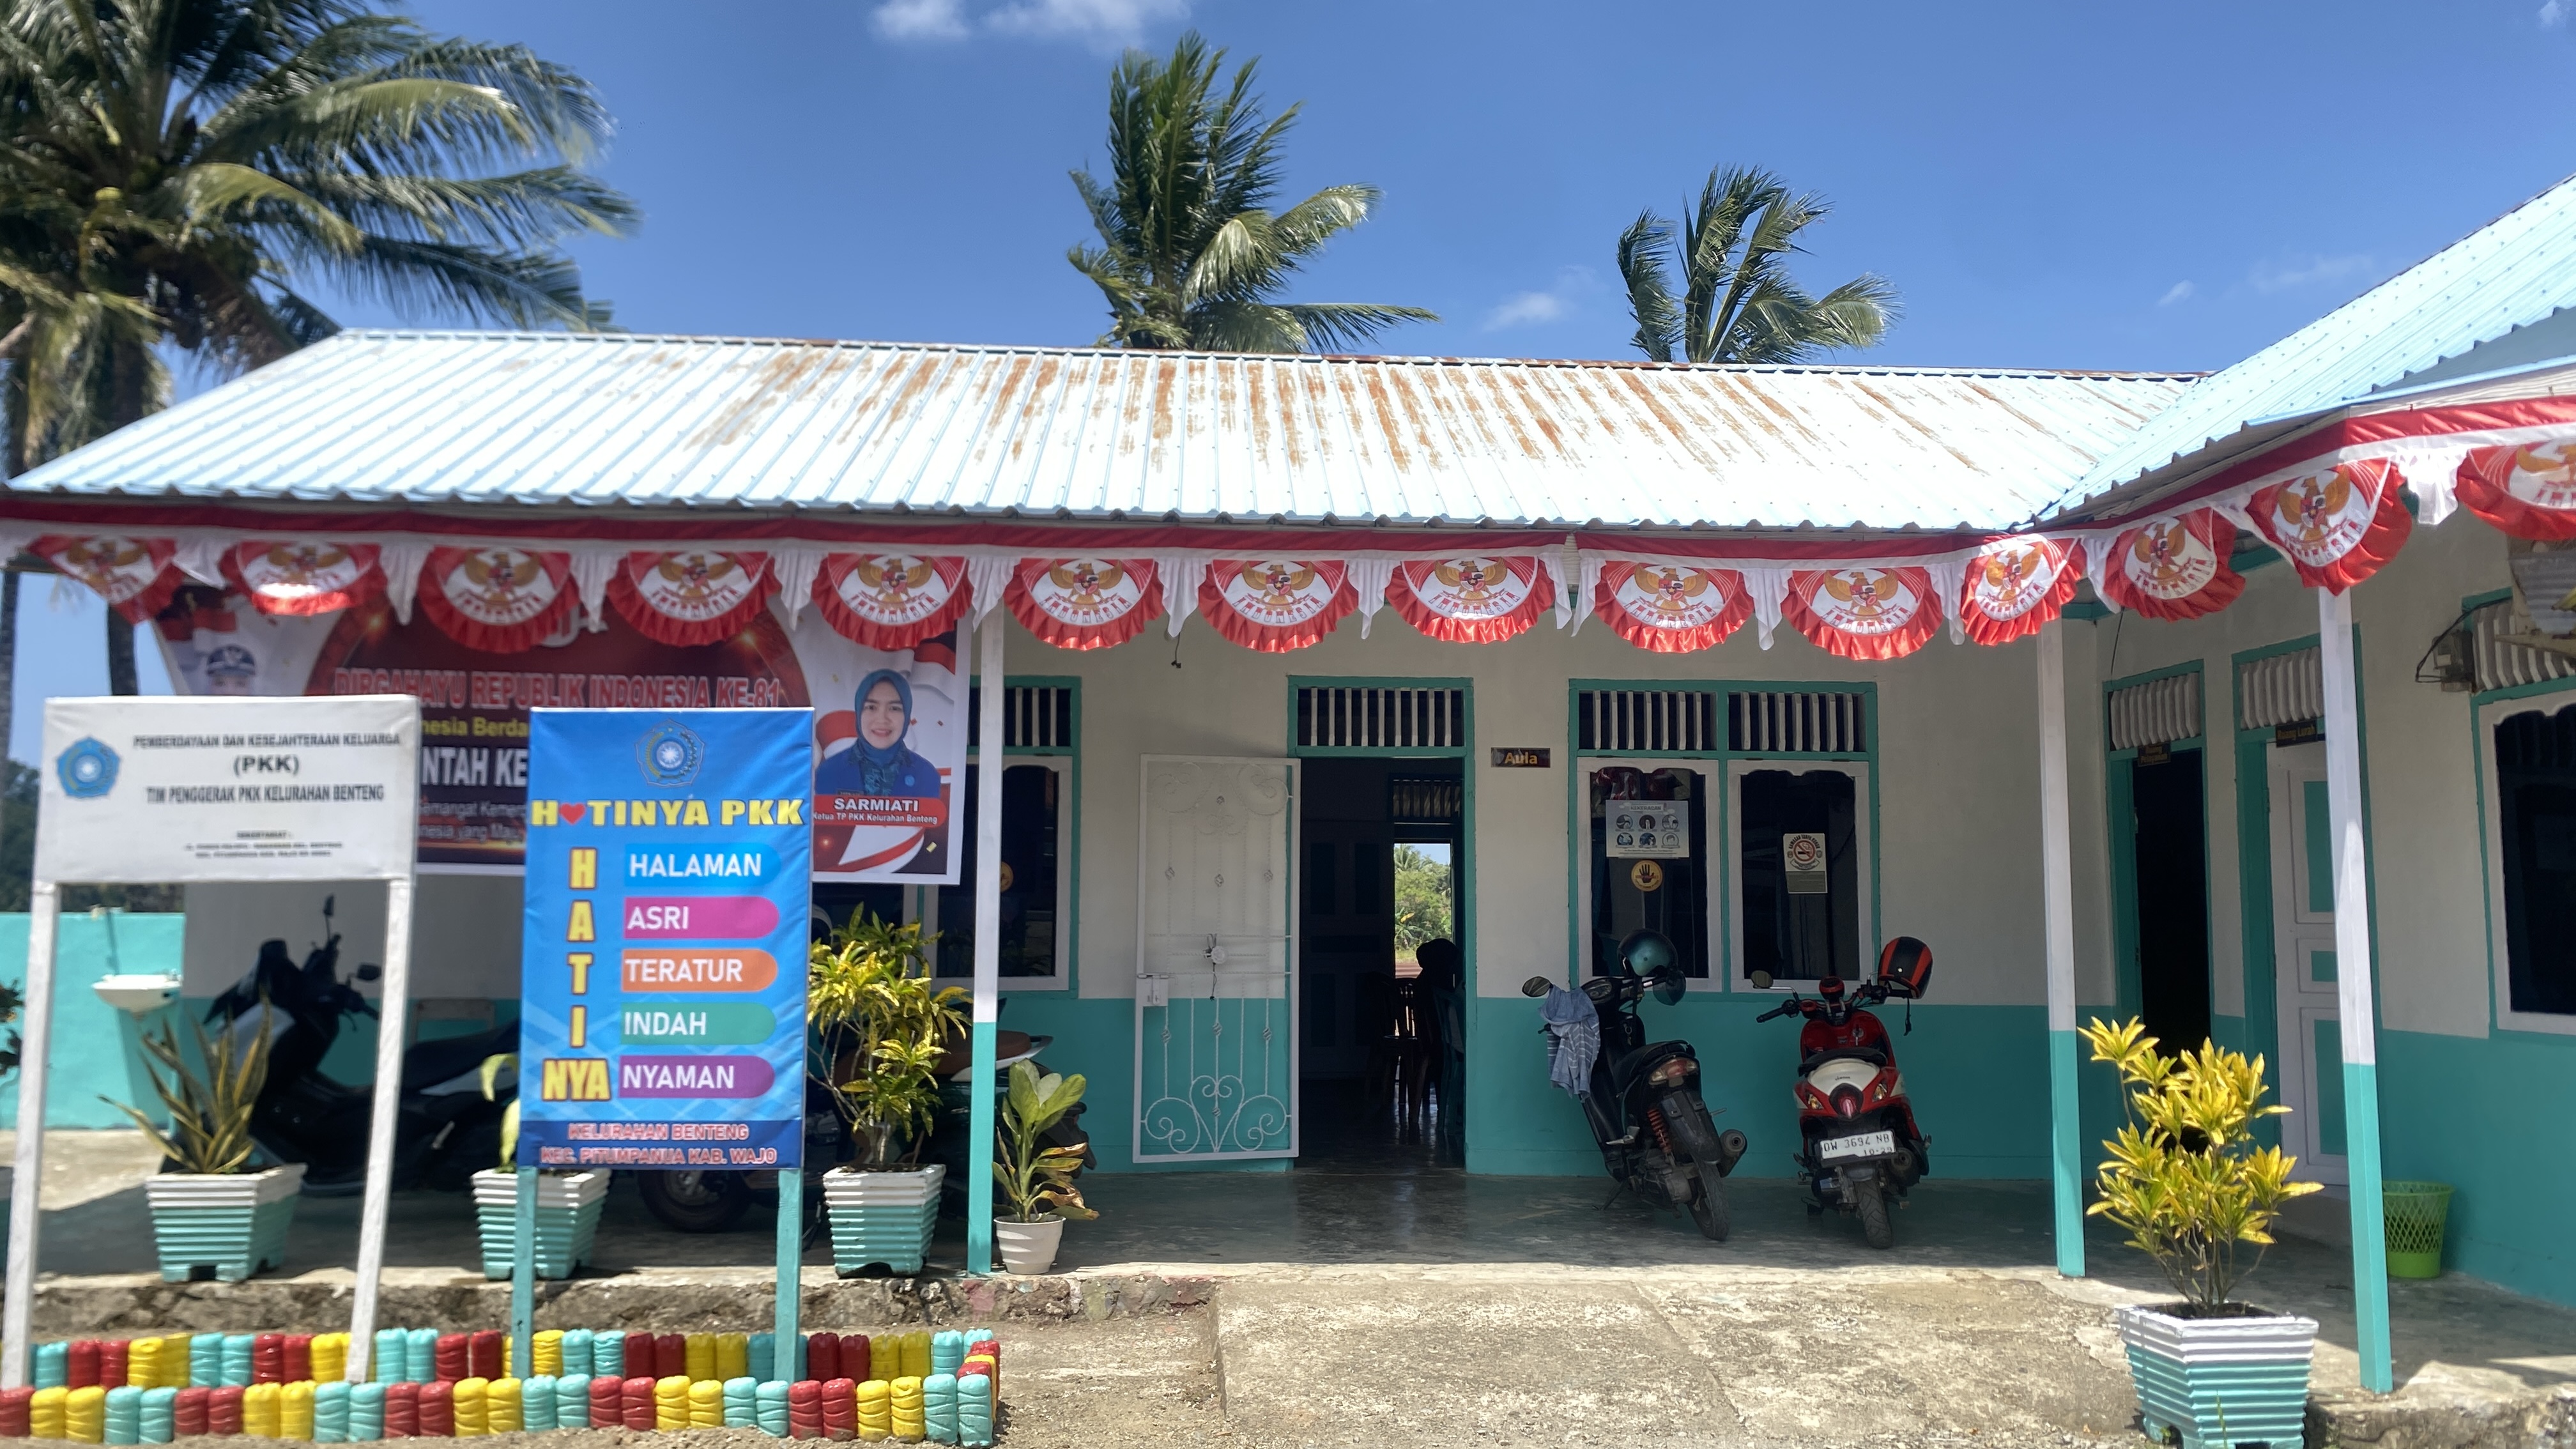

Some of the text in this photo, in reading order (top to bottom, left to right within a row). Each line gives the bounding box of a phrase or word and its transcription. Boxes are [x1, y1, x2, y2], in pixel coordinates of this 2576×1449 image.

[1039, 595, 1133, 624] INDONESIA
[1232, 595, 1325, 624] INDONESIA
[1428, 592, 1521, 617] INDONESIA
[1623, 599, 1717, 629] INDONESIA
[1821, 606, 1913, 634] INDONESIA
[334, 668, 780, 710] DIRGAHAYU REPUBLIK INDONESIA KE-81
[422, 716, 529, 737] nesia Berda
[222, 735, 244, 746] DAN
[247, 735, 339, 746] KESEJAHTERAAN
[343, 734, 400, 746] KELUARGA
[233, 755, 300, 778] (PKK)
[421, 746, 529, 787] NTAH KE
[1505, 752, 1538, 765] Aula
[147, 784, 385, 803] TIM PENGGERAK PKK KELURAHAN BENTENG
[834, 798, 919, 812] SARMIATI
[720, 799, 804, 825] PKK
[867, 813, 905, 822] Kelurahan
[907, 814, 938, 824] Benteng
[629, 853, 762, 877] HALAMAN
[627, 906, 689, 930] ASRI
[625, 959, 743, 982] TERATUR
[624, 1012, 706, 1036] INDAH
[541, 1059, 734, 1101] NYA NYAMAN
[568, 1123, 749, 1140] KELURAHAN BENTENG
[1844, 1136, 1871, 1149] 3694
[540, 1146, 778, 1165] KEC. PITUMPANUA KAB. WAJO
